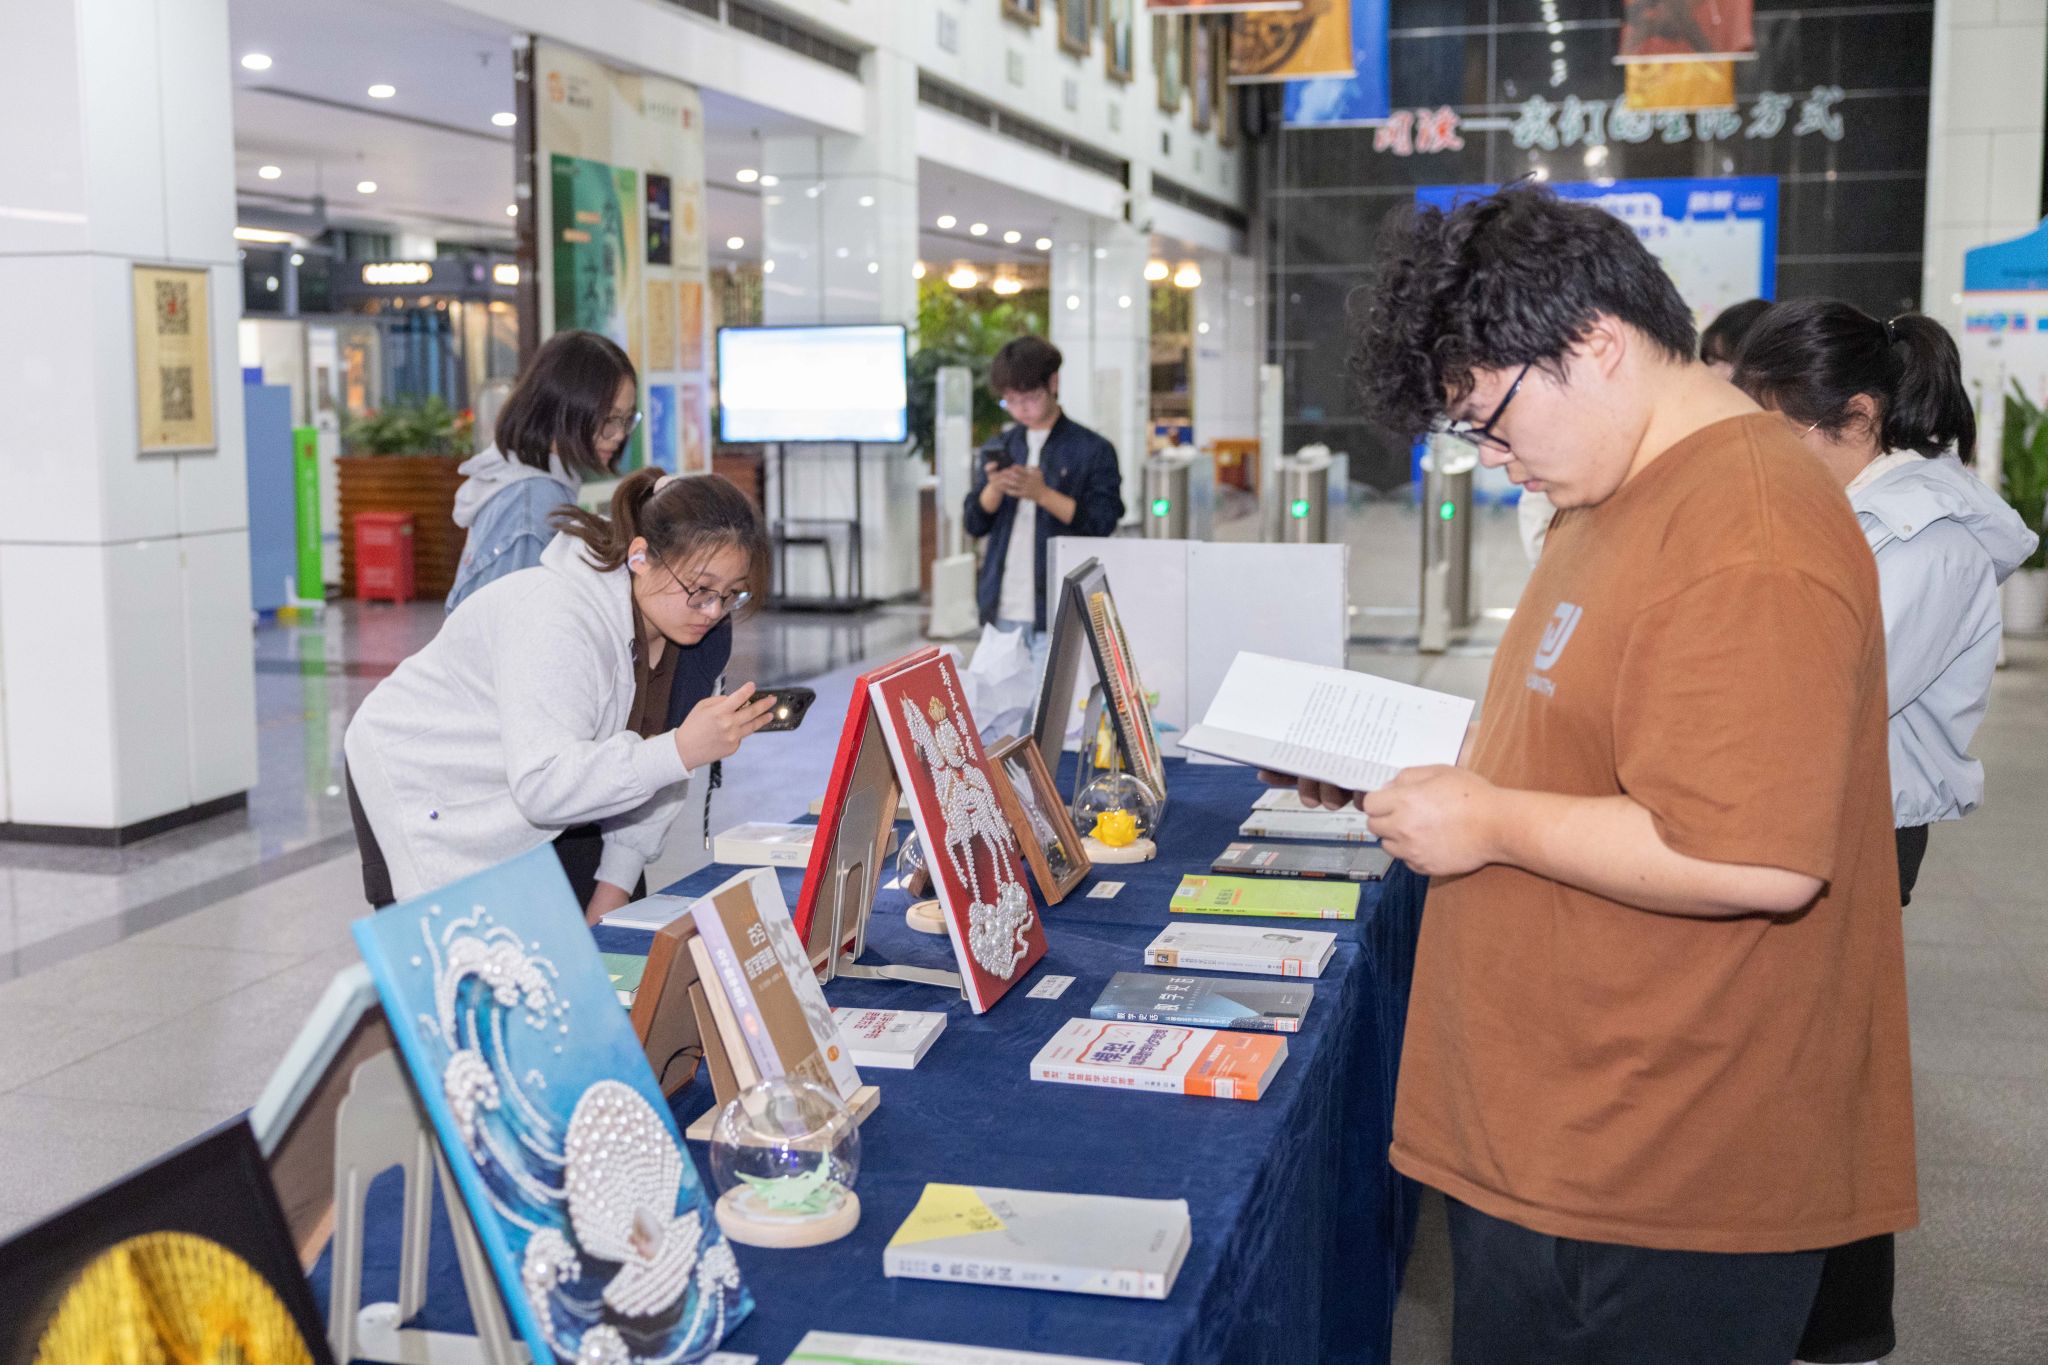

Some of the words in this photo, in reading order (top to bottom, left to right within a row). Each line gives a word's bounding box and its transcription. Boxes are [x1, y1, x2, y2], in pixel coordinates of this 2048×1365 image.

[1153, 977, 1195, 1012] 数学史话
[1116, 1012, 1159, 1021] 数学史话
